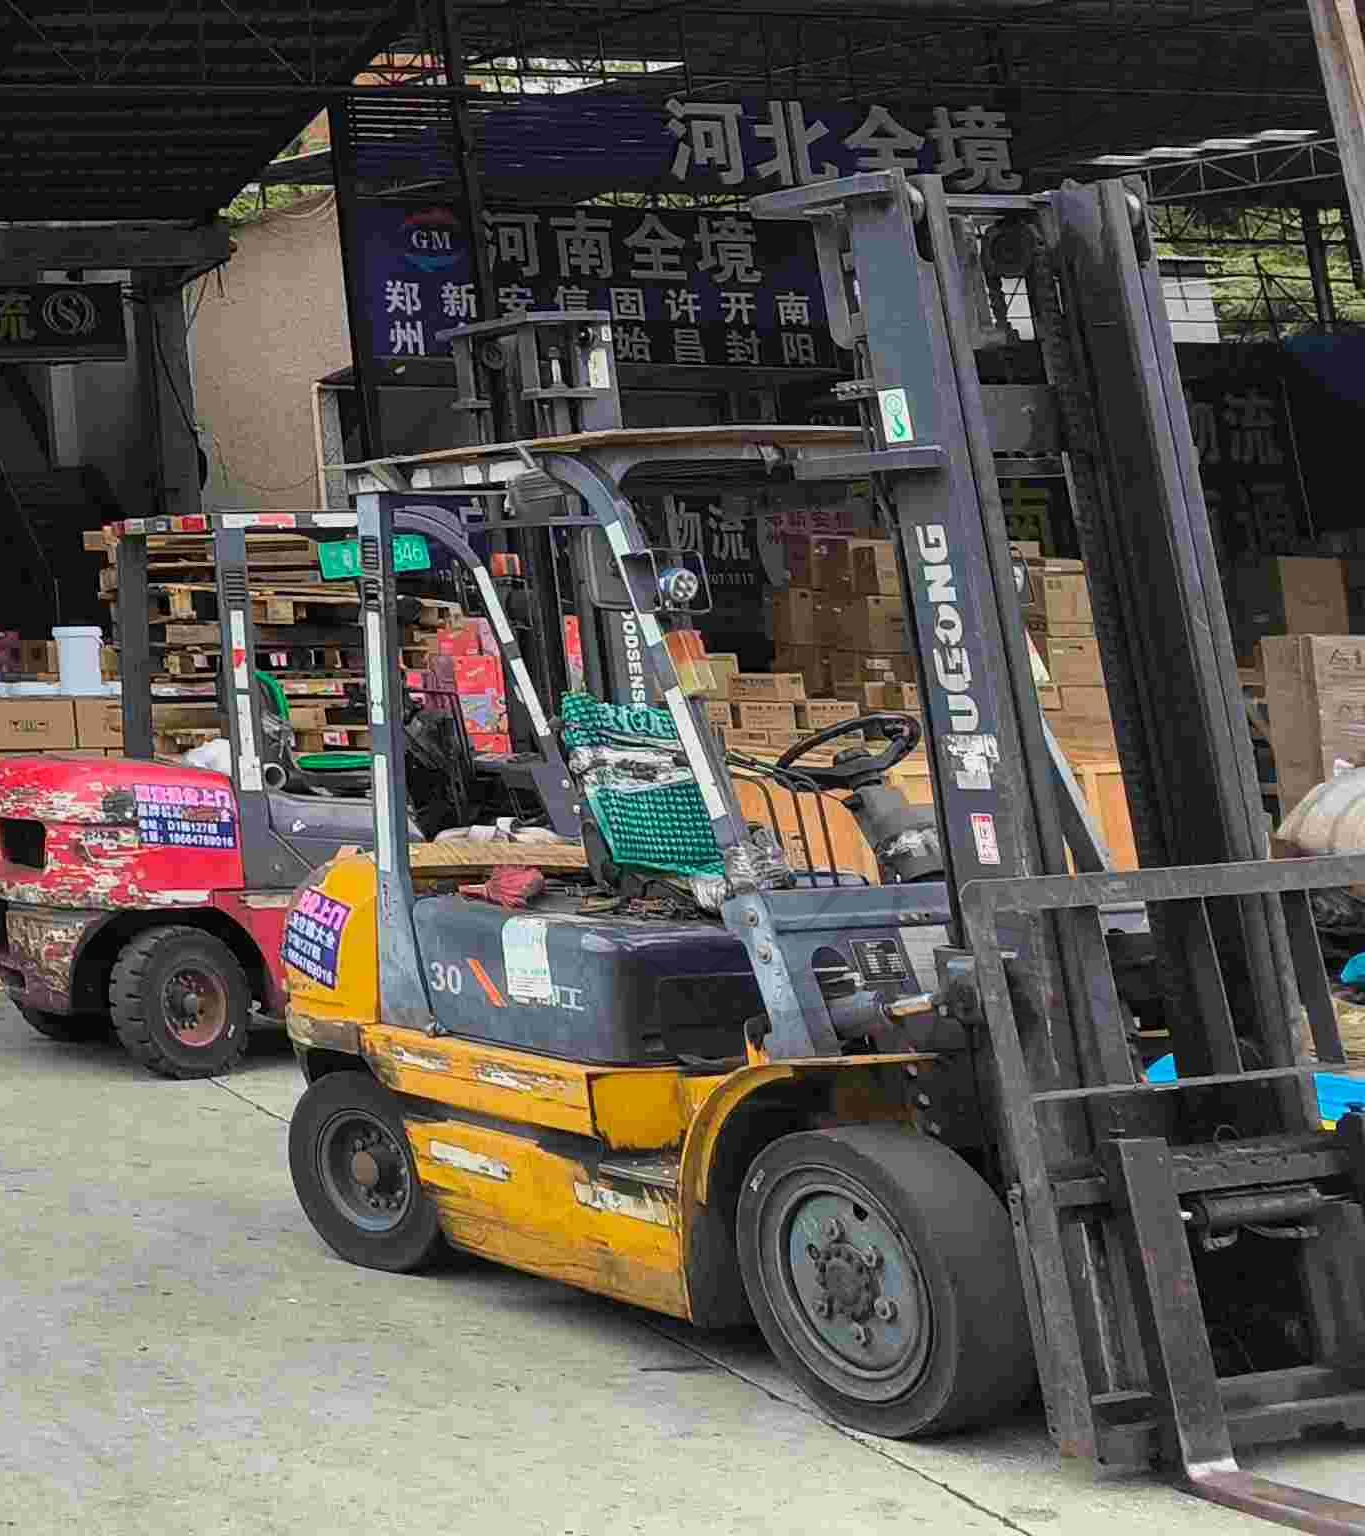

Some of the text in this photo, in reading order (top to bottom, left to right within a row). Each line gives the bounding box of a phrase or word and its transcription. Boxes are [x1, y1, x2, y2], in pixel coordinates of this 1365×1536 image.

[665, 94, 1024, 192] 河北全境
[481, 207, 766, 285] 河南全境
